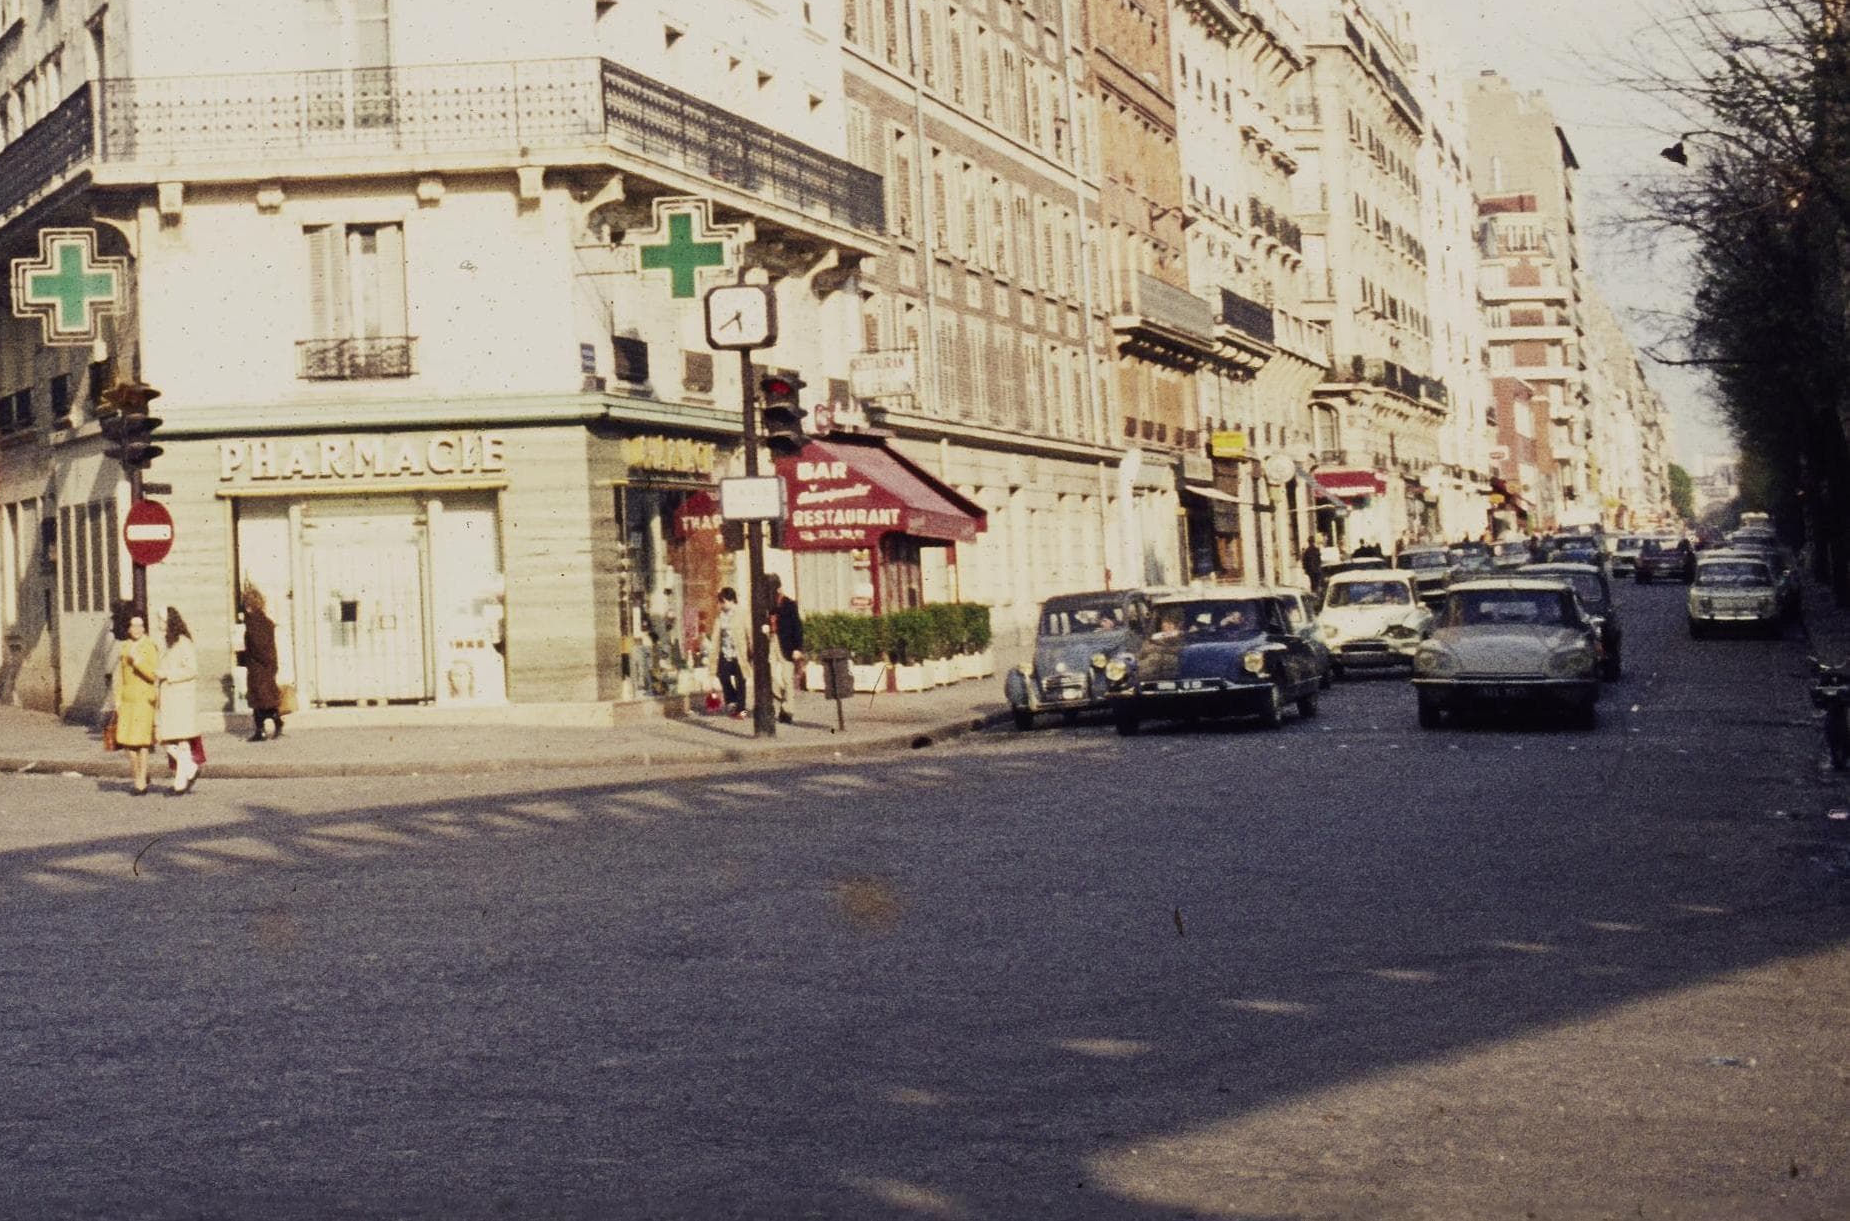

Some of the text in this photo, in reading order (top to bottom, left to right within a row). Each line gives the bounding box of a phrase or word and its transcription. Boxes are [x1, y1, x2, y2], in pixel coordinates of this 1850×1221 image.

[217, 432, 505, 482] PHARMACIE
[796, 461, 848, 481] BAR
[792, 508, 900, 527] RESTAURANT
